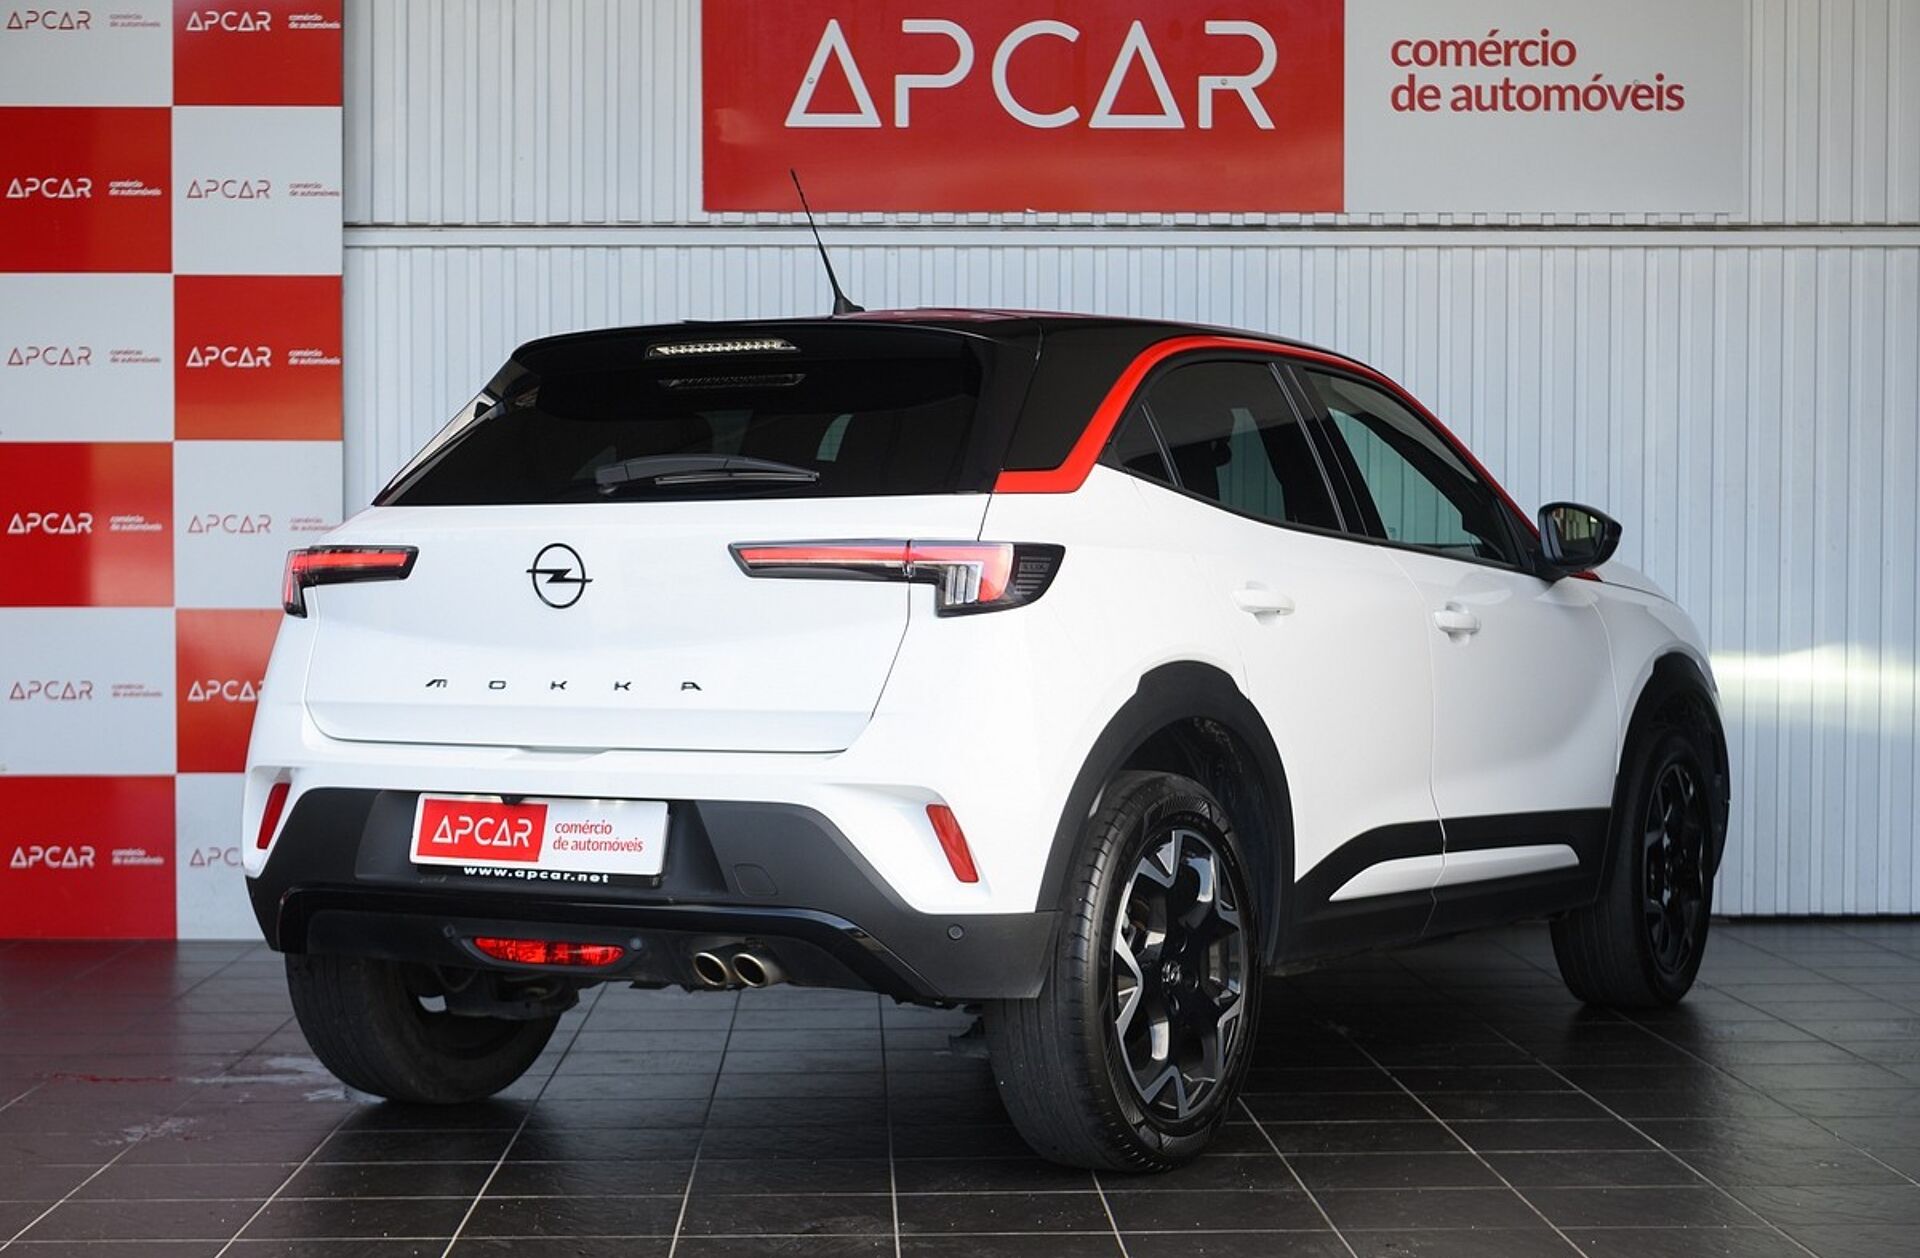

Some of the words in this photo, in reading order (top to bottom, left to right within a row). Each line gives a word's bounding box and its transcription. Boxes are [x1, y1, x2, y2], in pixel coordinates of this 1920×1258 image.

[7, 11, 91, 30] APCAR
[186, 11, 271, 31] APCAR
[1391, 28, 1577, 67] comércio
[785, 19, 1278, 129] APCAR
[1391, 73, 1441, 112] de
[1450, 73, 1686, 112] automóveis
[6, 178, 92, 199] APCAR
[187, 180, 271, 199] APCAR
[7, 346, 92, 366] APCAR
[186, 346, 272, 368] APCAR
[7, 513, 93, 534] APCAR
[188, 515, 271, 534] APCAR
[9, 681, 93, 700] APCAR
[425, 678, 702, 691] MOKKA
[432, 815, 533, 848] APCAR
[554, 819, 613, 835] comércio
[552, 836, 569, 851] de
[571, 836, 644, 852] automóveis
[10, 846, 95, 868] APCAR
[190, 847, 244, 867] APC
[463, 867, 609, 883] www.apcar.net
